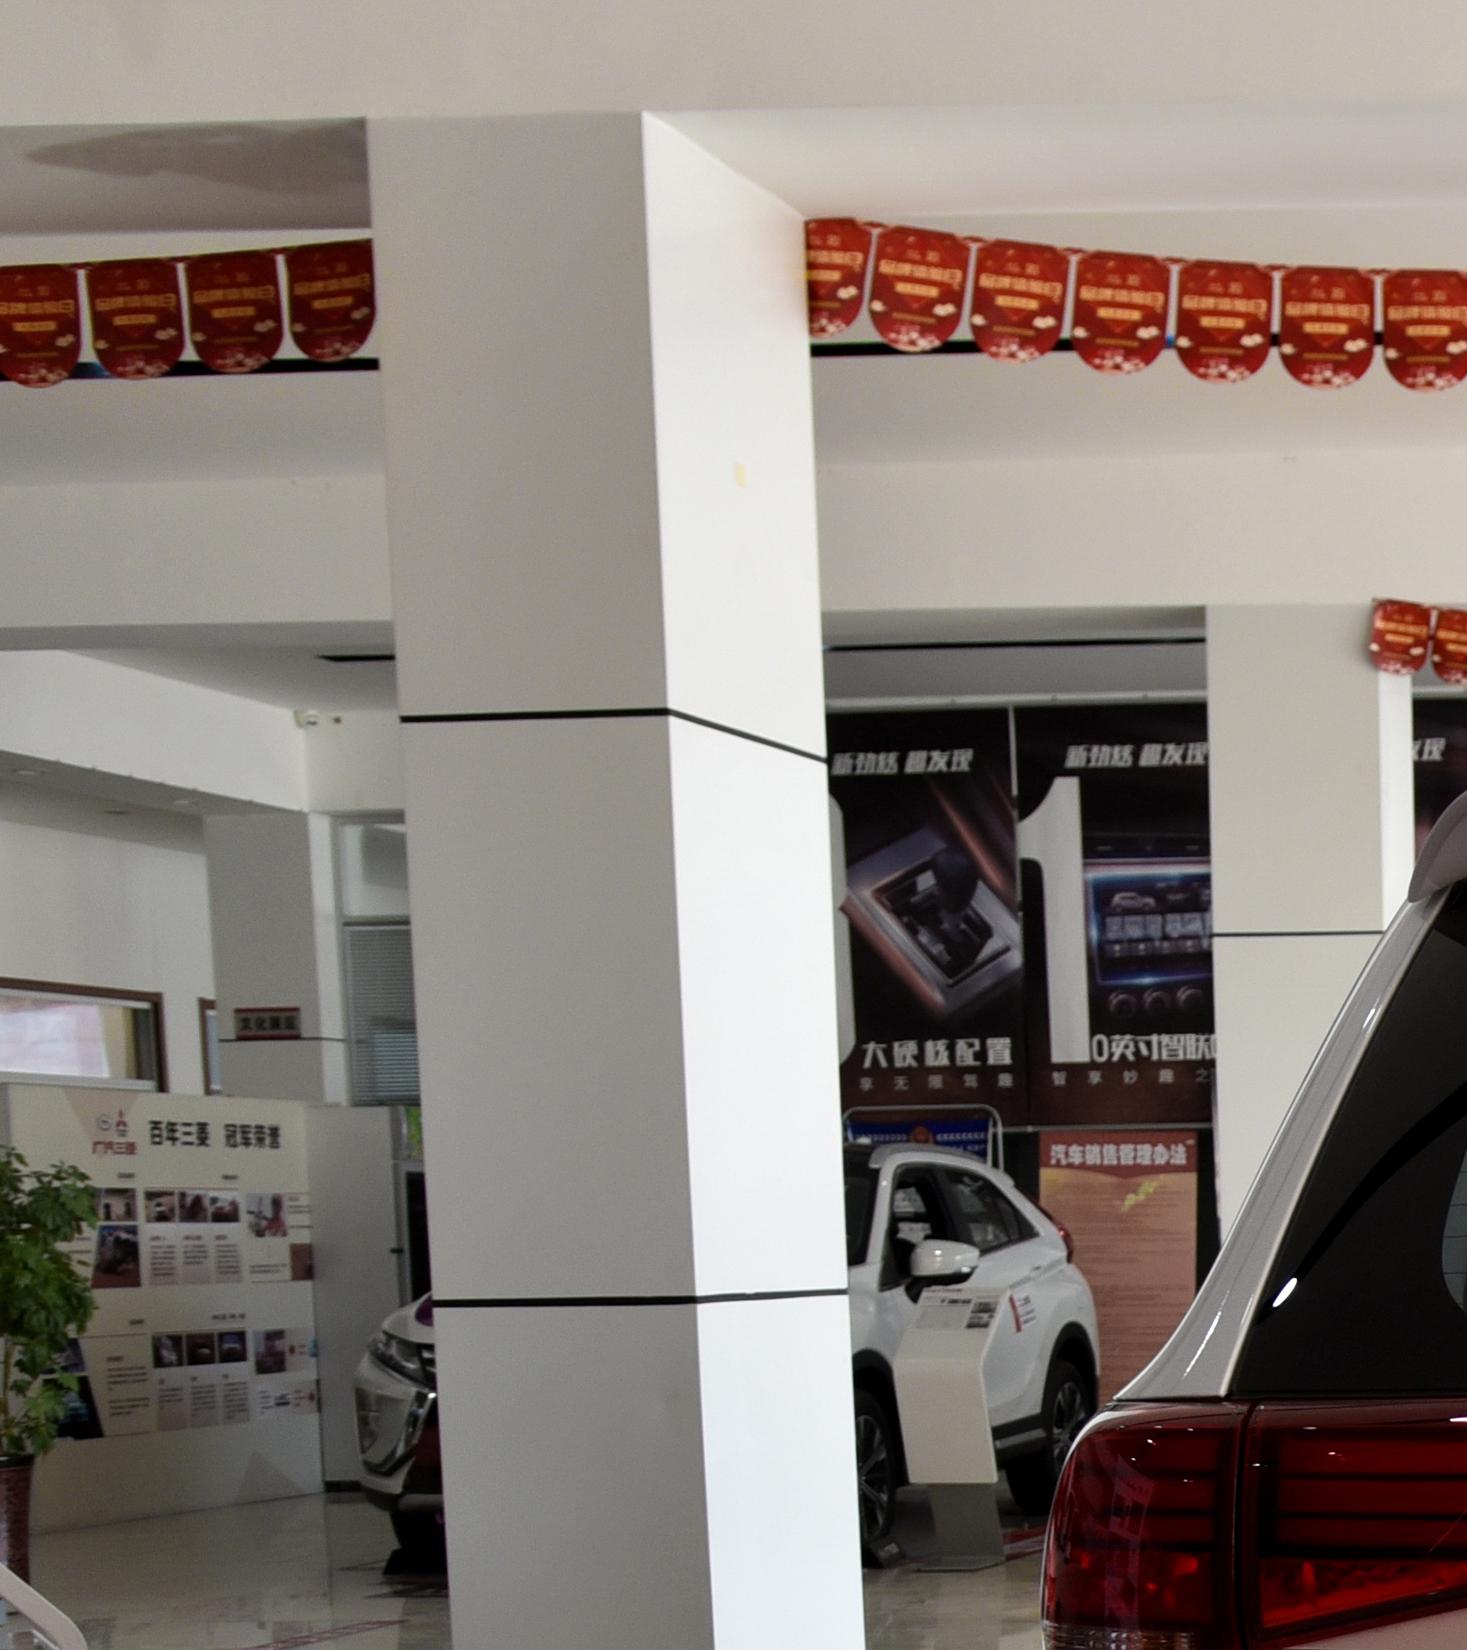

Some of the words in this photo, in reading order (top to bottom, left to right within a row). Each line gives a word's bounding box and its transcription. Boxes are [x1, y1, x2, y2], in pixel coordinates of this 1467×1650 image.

[861, 1037, 1014, 1069] 大硬核配置
[148, 1120, 210, 1147] 百年三菱
